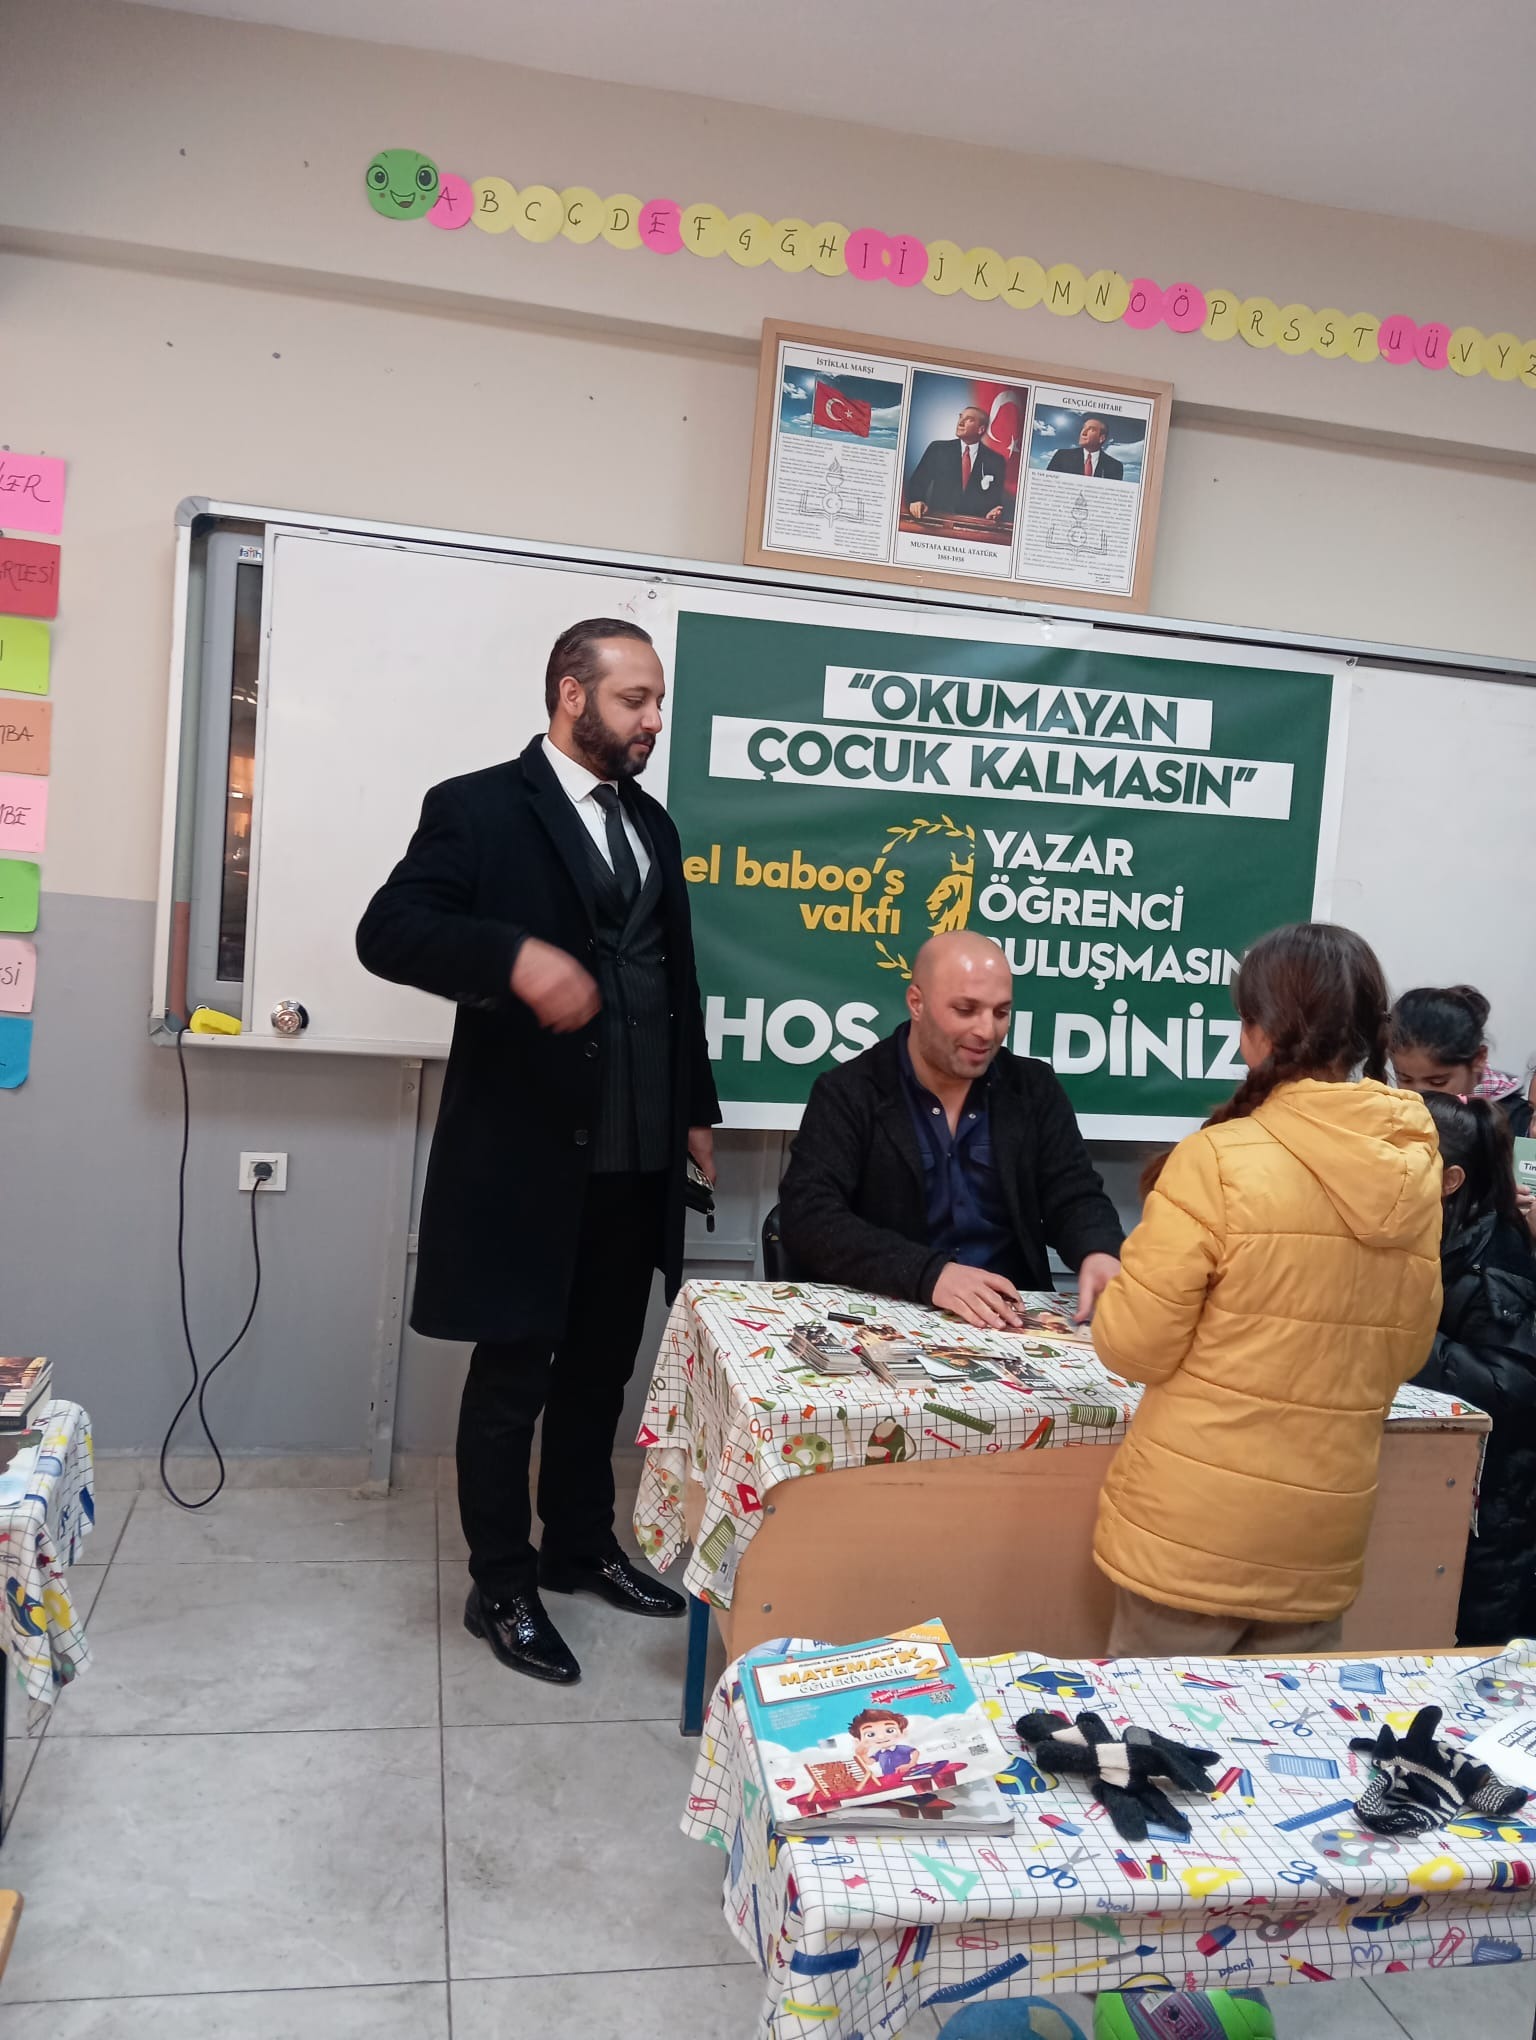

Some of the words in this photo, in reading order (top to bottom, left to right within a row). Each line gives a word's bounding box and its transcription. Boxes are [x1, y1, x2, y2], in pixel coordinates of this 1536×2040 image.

[435, 188, 457, 211] A
[480, 190, 499, 213] B
[525, 202, 541, 221] C
[568, 203, 583, 226] Ç
[610, 208, 629, 231] D
[648, 212, 670, 234] E
[694, 216, 712, 240] F
[739, 229, 751, 251] G
[781, 229, 798, 256] Ğ
[819, 236, 837, 258] H
[974, 262, 988, 287] K
[1008, 272, 1024, 293] L
[1052, 281, 1070, 304] M
[1096, 282, 1110, 306] N
[1131, 292, 1146, 312] O
[1173, 288, 1189, 316] Ö
[1211, 300, 1227, 325] P
[1251, 310, 1264, 336] R
[1283, 318, 1300, 341] S
[1320, 323, 1334, 347] Ş
[1353, 327, 1373, 348] T
[1389, 331, 1401, 349] U
[1425, 329, 1438, 358] Ü
[1461, 342, 1473, 362] V
[1498, 345, 1510, 368] Y
[816, 357, 849, 369] İSTİKLAL
[851, 364, 875, 374] MARŞI
[1098, 402, 1122, 412] HİTABE
[911, 541, 942, 551] MUSTAFA
[943, 544, 966, 553] KEMAL
[968, 549, 998, 558] ATATÜRK
[0, 560, 55, 591] RTESİ
[848, 673, 1179, 744] “OKUMAYAN
[747, 727, 953, 782] ÇOCUK
[970, 745, 1258, 808] KALMASIN”
[0, 804, 32, 826] BE
[683, 844, 721, 884] el
[982, 829, 1134, 877] YAZAR
[799, 893, 901, 935] vakfı
[978, 875, 1184, 932] ÖĞRENCİ
[0, 961, 22, 986] Sİ
[1001, 999, 1250, 1081] LDİNİZ
[914, 1658, 940, 1681] 2
[910, 1887, 937, 1905] pen
[1219, 1958, 1254, 1978] pencil
